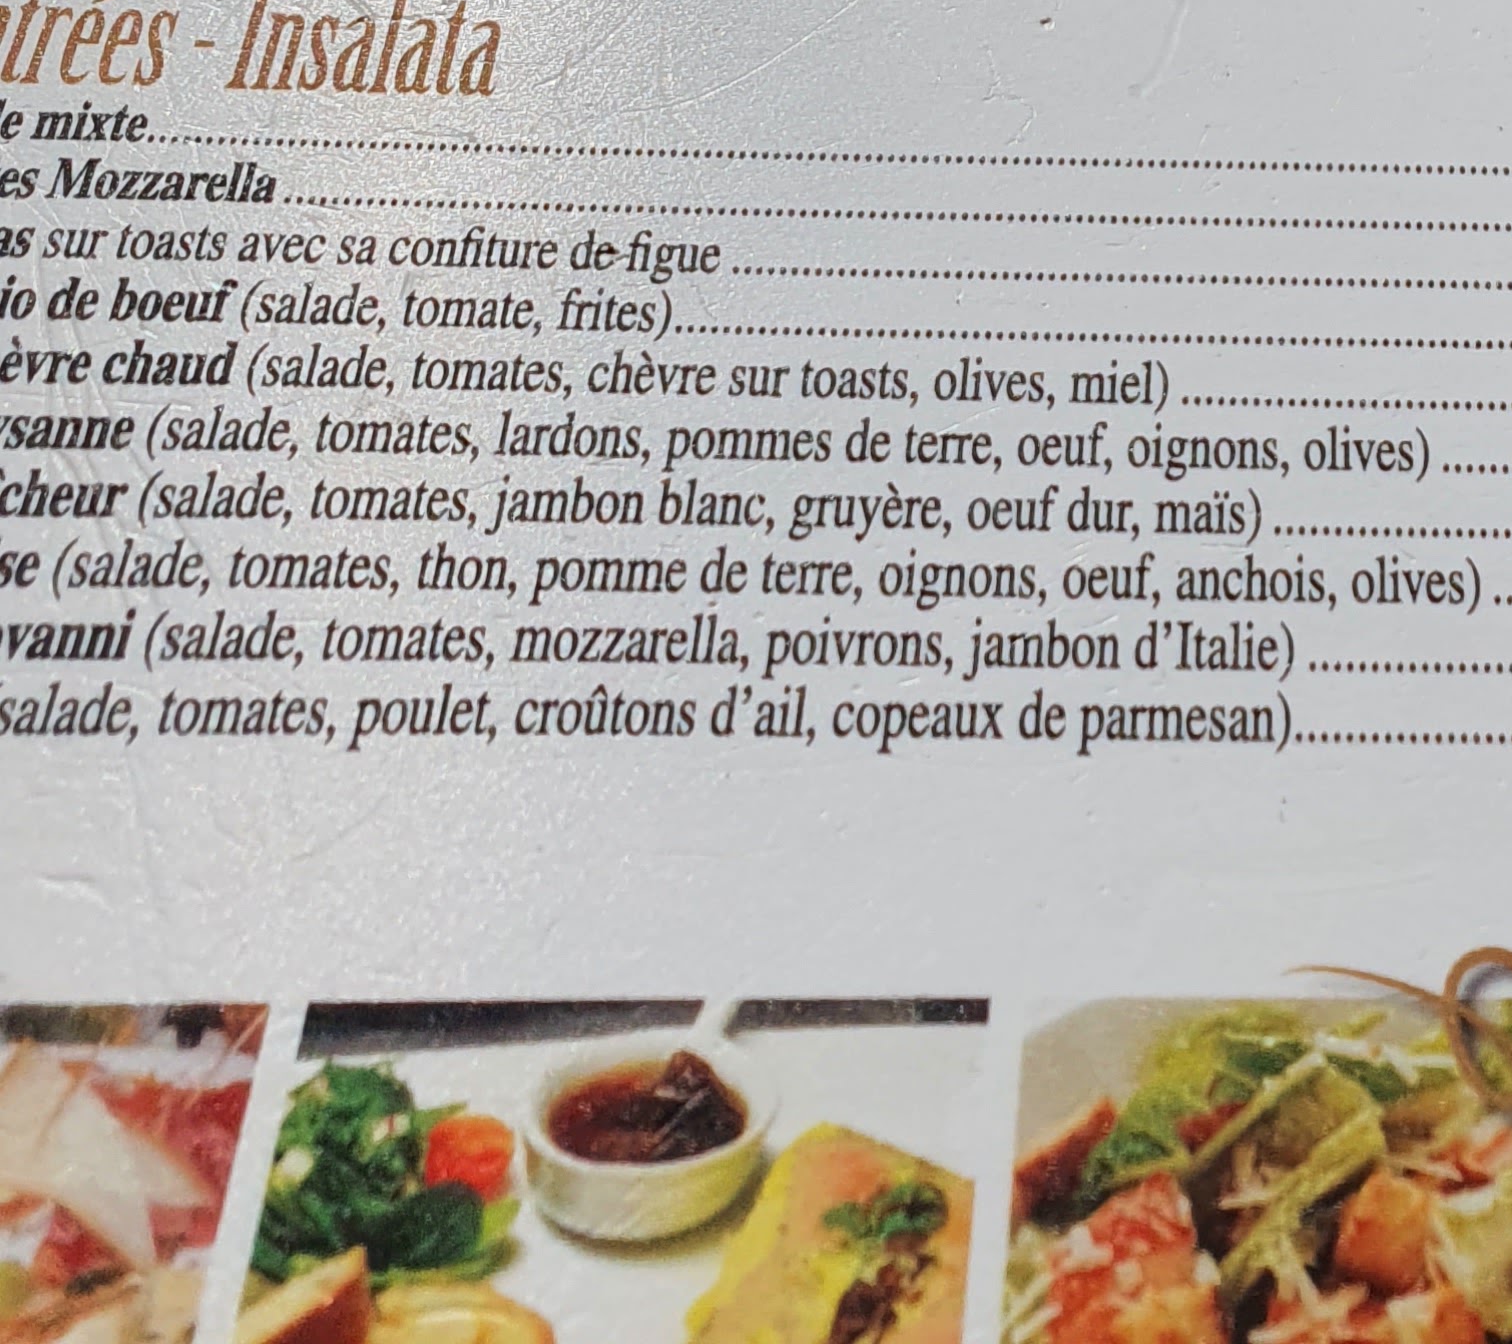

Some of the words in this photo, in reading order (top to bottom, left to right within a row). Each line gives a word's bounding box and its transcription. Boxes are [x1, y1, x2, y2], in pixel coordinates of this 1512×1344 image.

[46, 158, 276, 203] Mozzarella
[42, 228, 109, 259] sur
[116, 225, 227, 261] toasts
[237, 233, 326, 264] avec
[337, 236, 376, 265] sa
[388, 226, 558, 270] confiture
[570, 229, 618, 270] de
[627, 228, 721, 286] figue
[46, 276, 99, 321] de
[109, 277, 238, 323] boeuf
[240, 281, 386, 333] (salade,
[403, 291, 541, 336] tomate,
[557, 287, 672, 340] frites)
[102, 339, 238, 386] chaud
[247, 343, 394, 395] (salade,
[412, 353, 572, 399] tomates,
[588, 350, 716, 396] chèvre
[728, 366, 790, 397] sur
[801, 362, 918, 406] toasts,
[934, 357, 1055, 409] olives,
[1070, 360, 1168, 413] miel)
[0, 608, 136, 660] vanni
[144, 610, 303, 670] (salade,
[322, 620, 494, 670] tomates,
[510, 614, 748, 671] mozzarella,
[763, 616, 953, 679] poivrons,
[963, 618, 1119, 681] jambon
[1135, 621, 1294, 680] d'Italie)
[0, 682, 138, 743] salade,
[158, 692, 335, 742] tomates,
[347, 683, 496, 751] poulet,
[515, 684, 696, 736] croûtons
[832, 702, 1002, 754] copeaux
[1019, 689, 1065, 740] de
[1078, 694, 1291, 756] parmesan)
